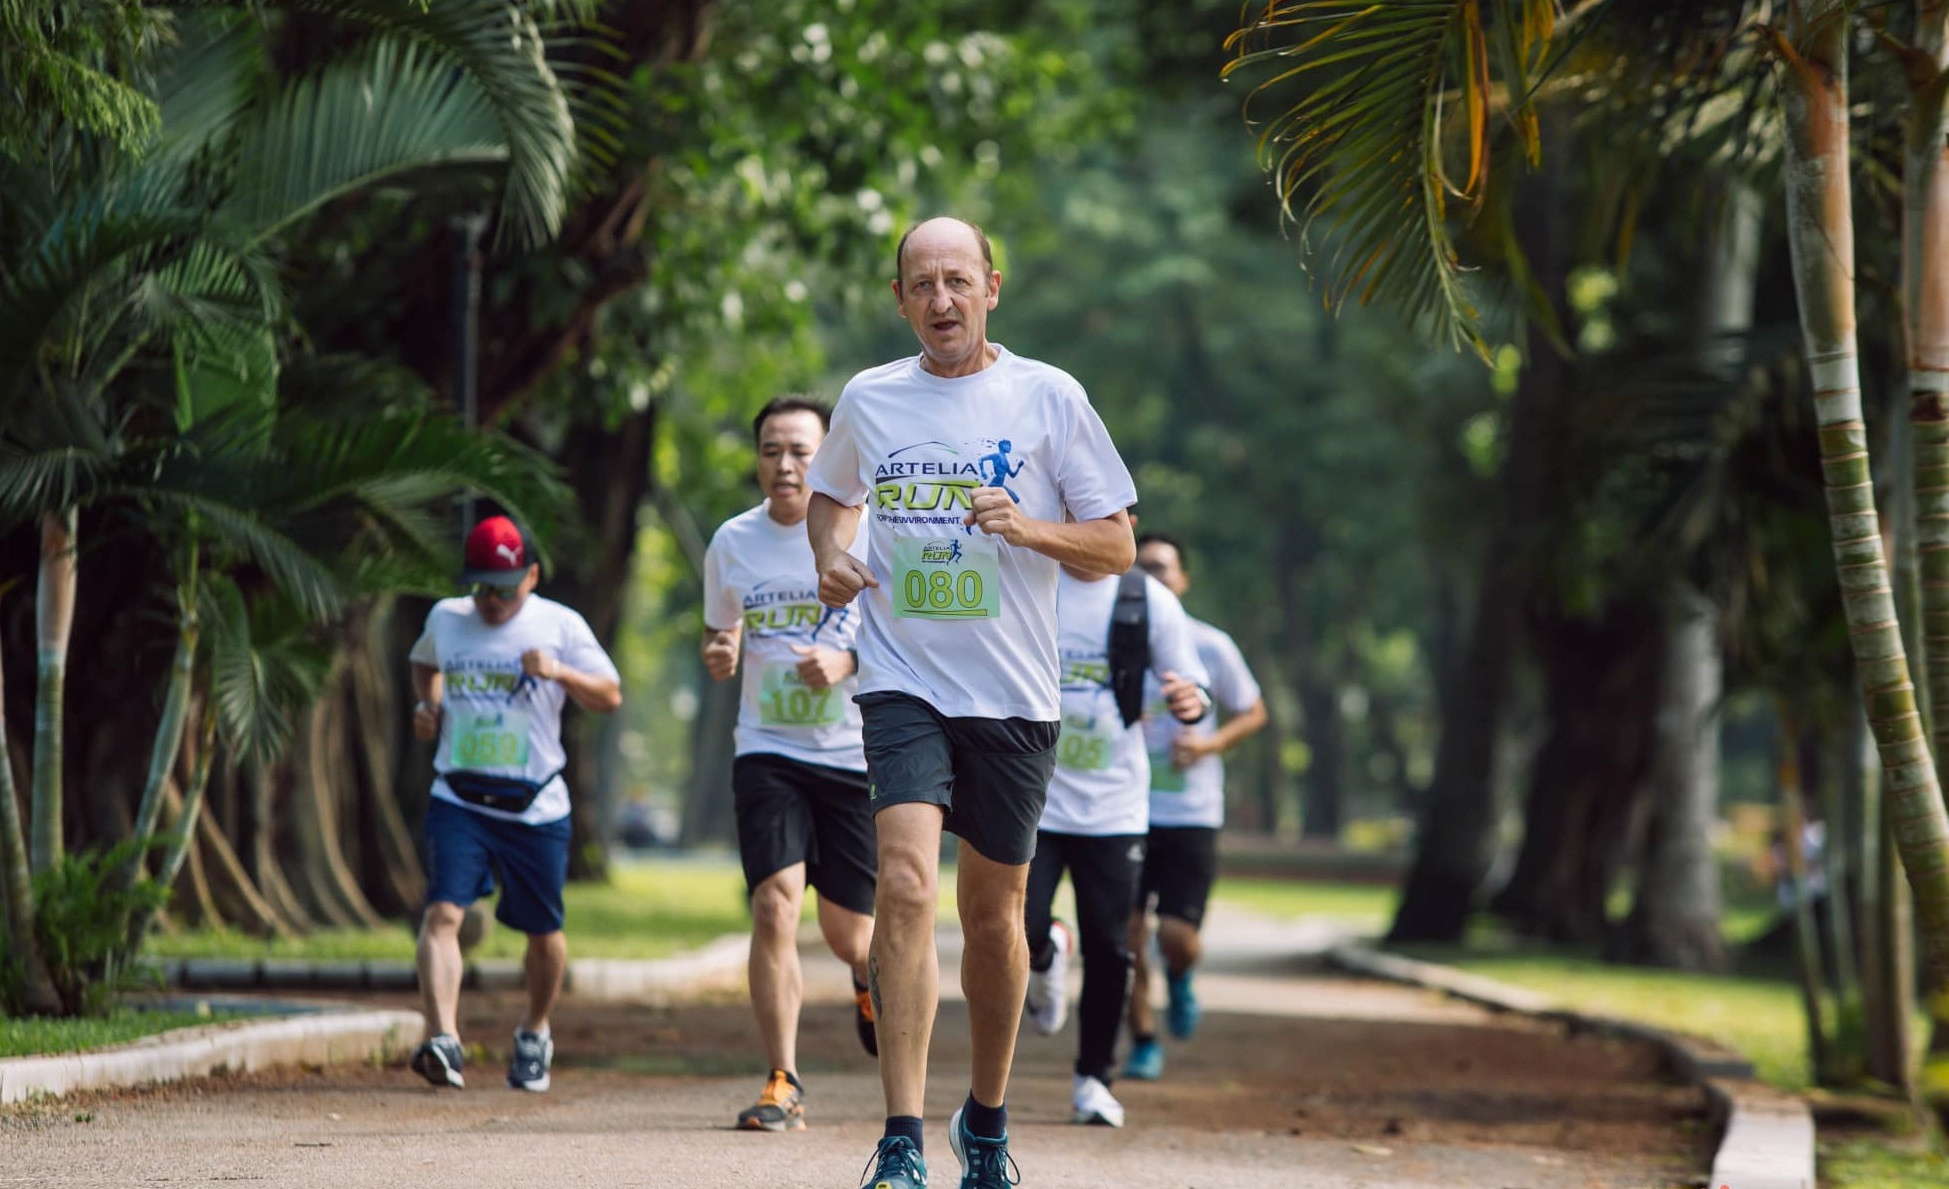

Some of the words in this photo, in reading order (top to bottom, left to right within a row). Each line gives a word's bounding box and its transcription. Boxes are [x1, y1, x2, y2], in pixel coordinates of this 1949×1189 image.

[875, 462, 978, 476] ARTELIA
[876, 481, 983, 511] RUN
[744, 589, 817, 604] ARTELIA
[905, 570, 983, 608] 080
[744, 604, 821, 630] RUN
[772, 687, 832, 721] 107
